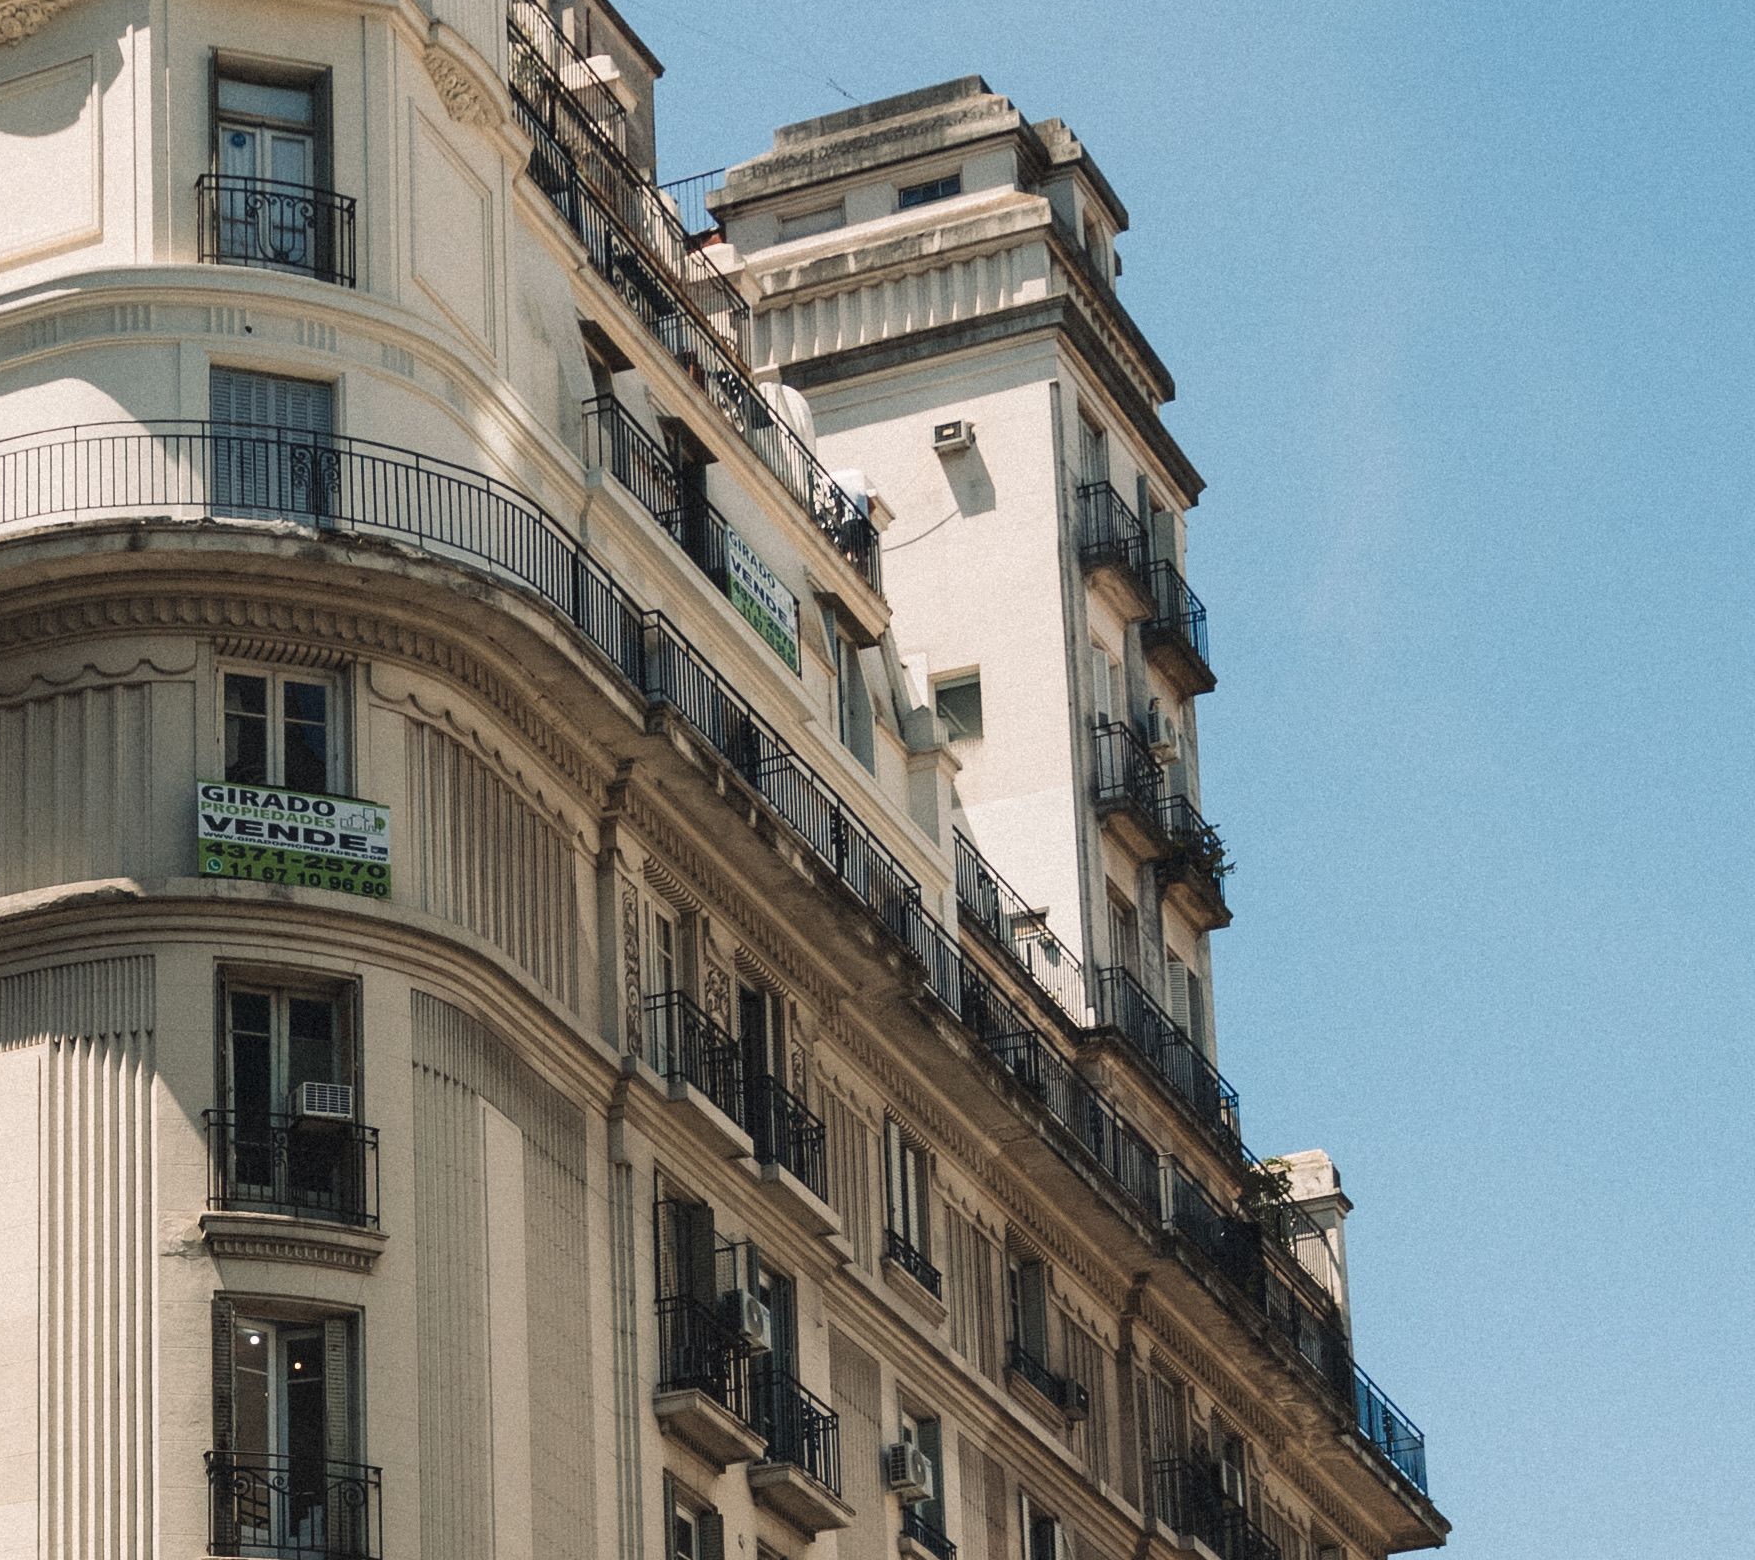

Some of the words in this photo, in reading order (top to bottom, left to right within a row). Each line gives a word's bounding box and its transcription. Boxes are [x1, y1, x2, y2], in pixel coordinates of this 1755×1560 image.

[729, 530, 775, 589] GIRADO
[731, 554, 788, 624] VENDE
[200, 801, 336, 829] PROPIEDADES
[201, 785, 336, 817] GIRADO
[202, 814, 368, 853] VENDE
[205, 841, 386, 879] 4371-2570
[230, 862, 252, 878] 11
[262, 866, 288, 881] 67
[297, 871, 321, 887] 10
[329, 876, 355, 891] 96
[361, 881, 387, 896] 80
